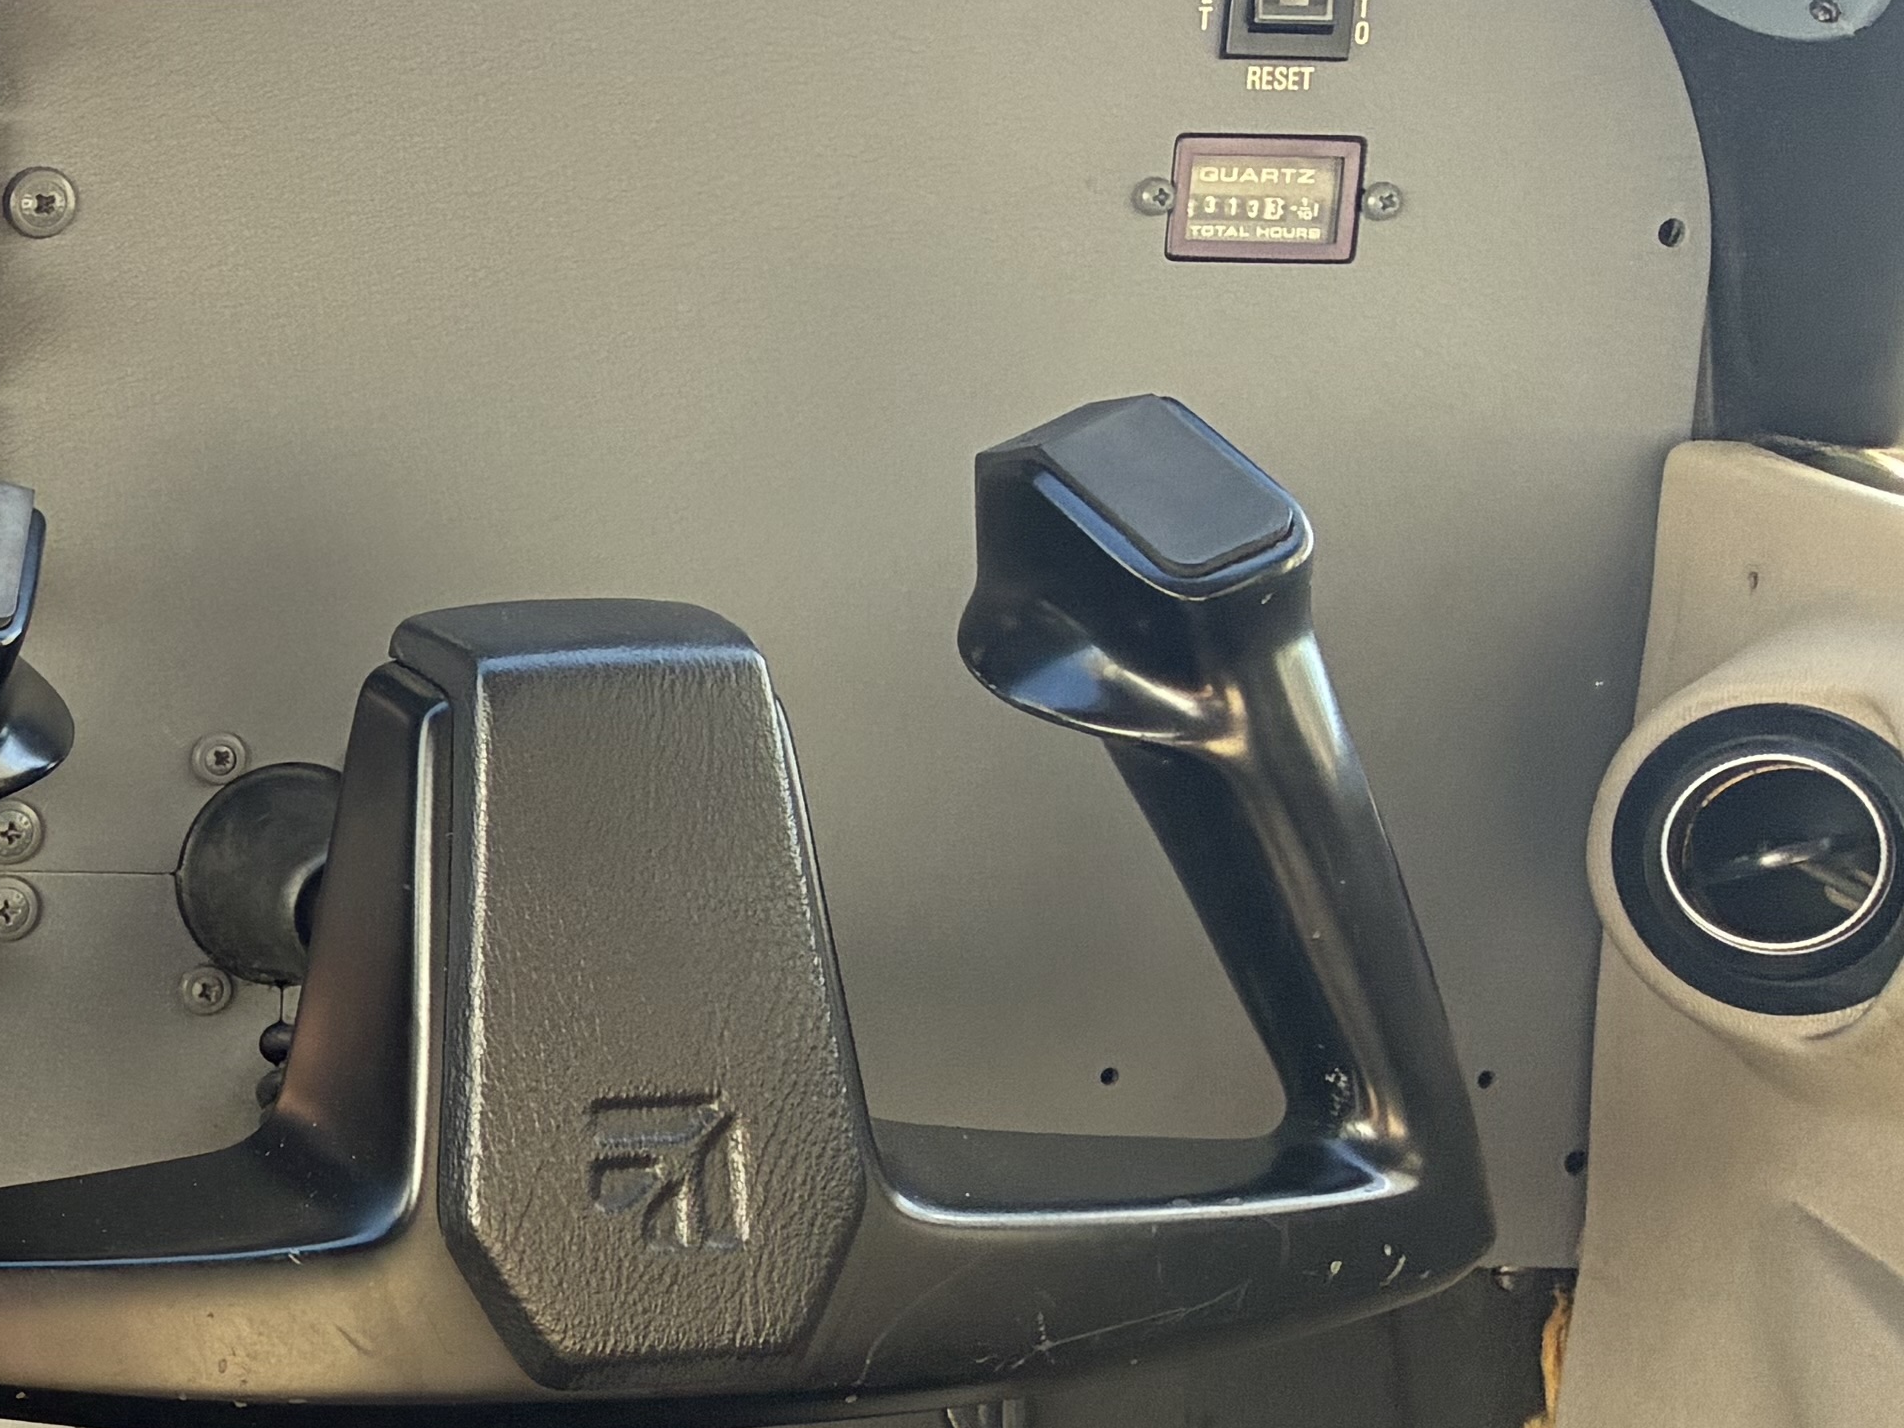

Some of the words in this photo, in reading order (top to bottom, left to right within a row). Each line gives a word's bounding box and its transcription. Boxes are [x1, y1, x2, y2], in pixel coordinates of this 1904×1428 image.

[1246, 65, 1316, 92] RESET
[1198, 166, 1317, 185] QUARTZ
[1188, 224, 1251, 239] TOTAL
[1255, 225, 1321, 240] HOURS
